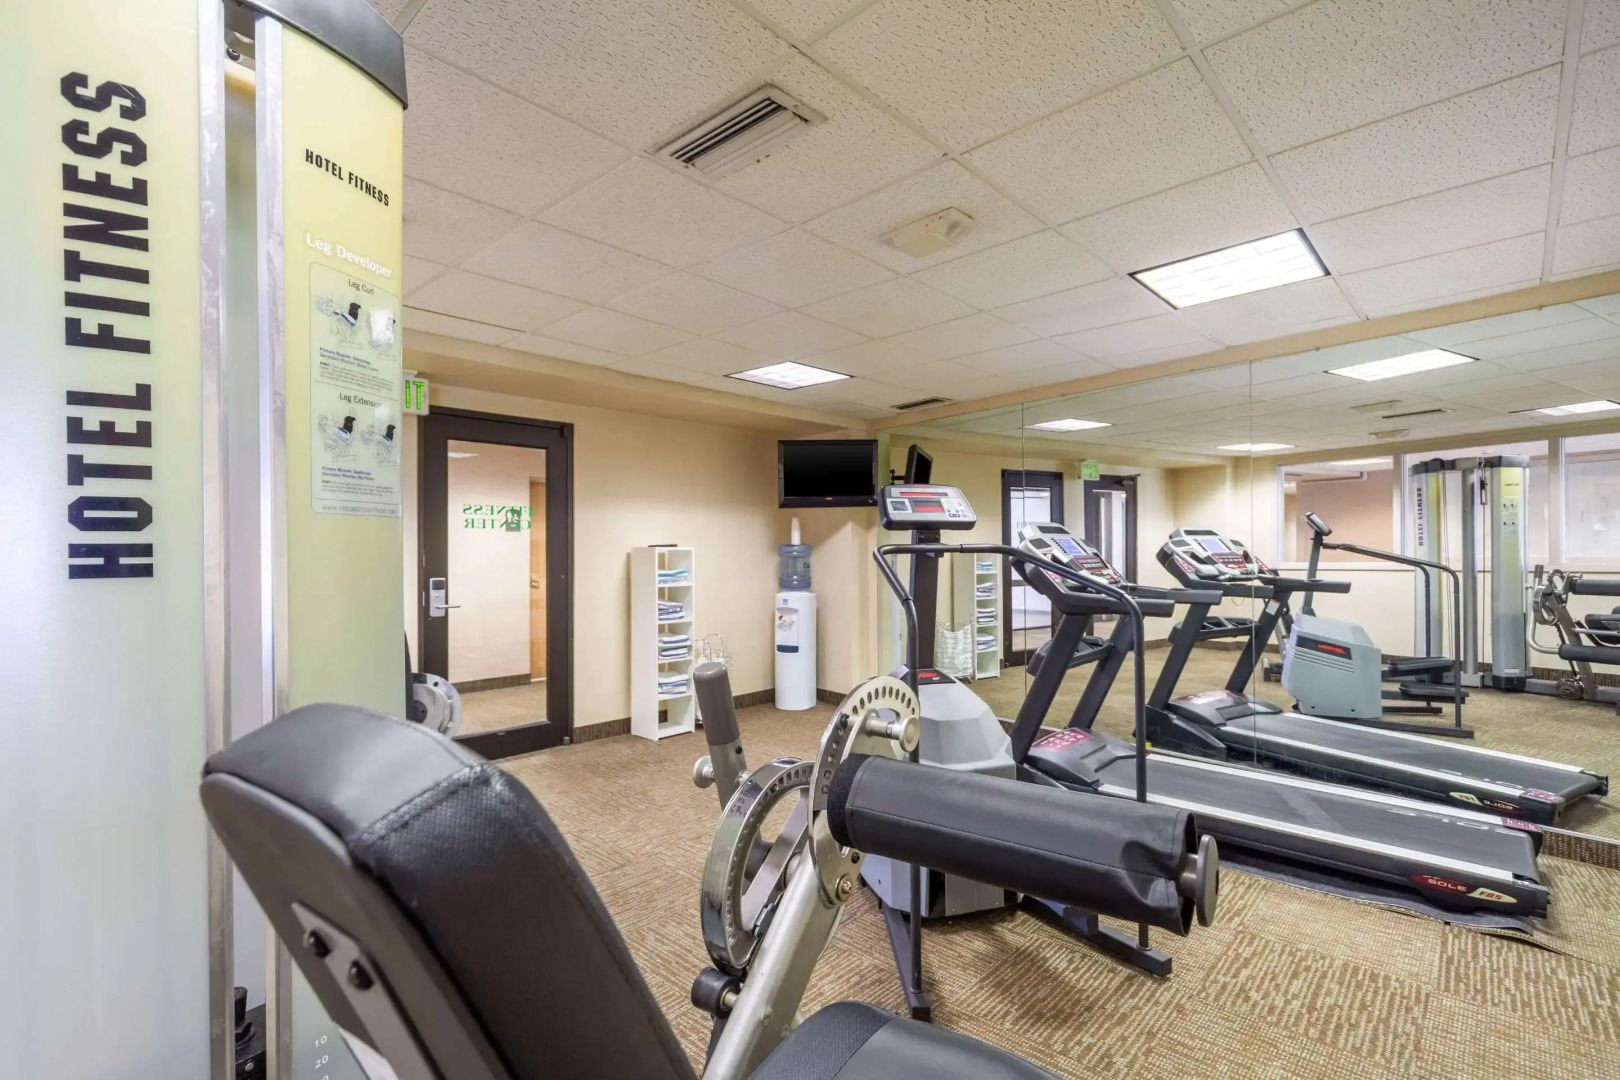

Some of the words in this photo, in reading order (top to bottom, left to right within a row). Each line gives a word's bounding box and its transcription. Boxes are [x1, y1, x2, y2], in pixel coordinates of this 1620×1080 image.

[305, 148, 344, 181] HOTEL
[348, 171, 389, 207] FITNESS
[60, 71, 151, 354] FITNESS
[306, 232, 332, 256] Leg
[336, 244, 392, 278] Developer
[348, 278, 361, 292] Leg
[361, 284, 375, 296] Curl
[339, 392, 352, 404] Leg
[353, 395, 383, 408] Extension
[405, 379, 426, 410] IT
[66, 383, 153, 579] HOTEL
[1427, 878, 1468, 892] SOLE
[1479, 890, 1504, 901] F85
[314, 1035, 328, 1048] 10
[315, 1054, 329, 1069] 20
